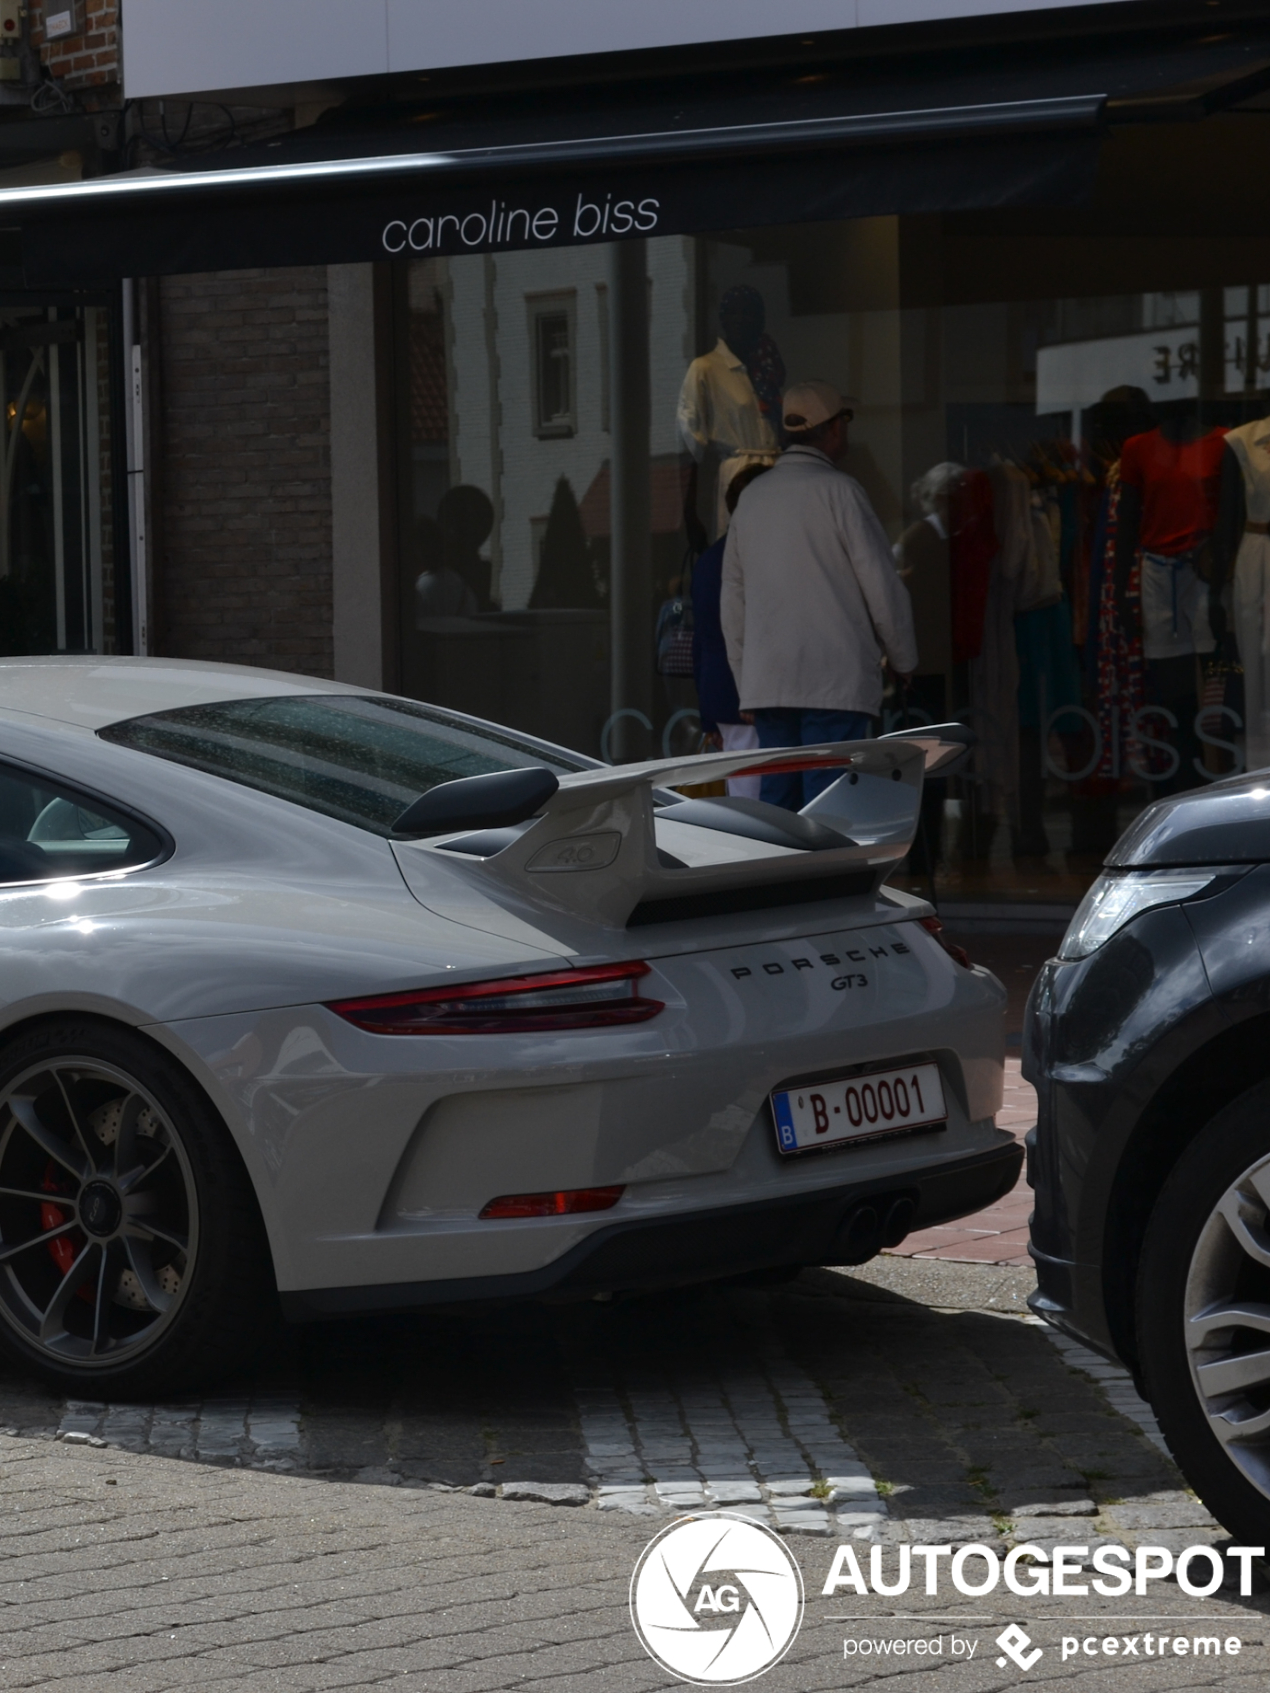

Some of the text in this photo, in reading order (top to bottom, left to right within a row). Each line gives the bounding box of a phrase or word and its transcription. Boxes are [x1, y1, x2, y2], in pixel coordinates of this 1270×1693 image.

[382, 193, 660, 252] caroline biss
[1038, 672, 1245, 781] biss
[730, 942, 911, 980] PORSCHE
[831, 974, 868, 991] GT3
[781, 1125, 793, 1145] B
[809, 1074, 925, 1135] B-00001
